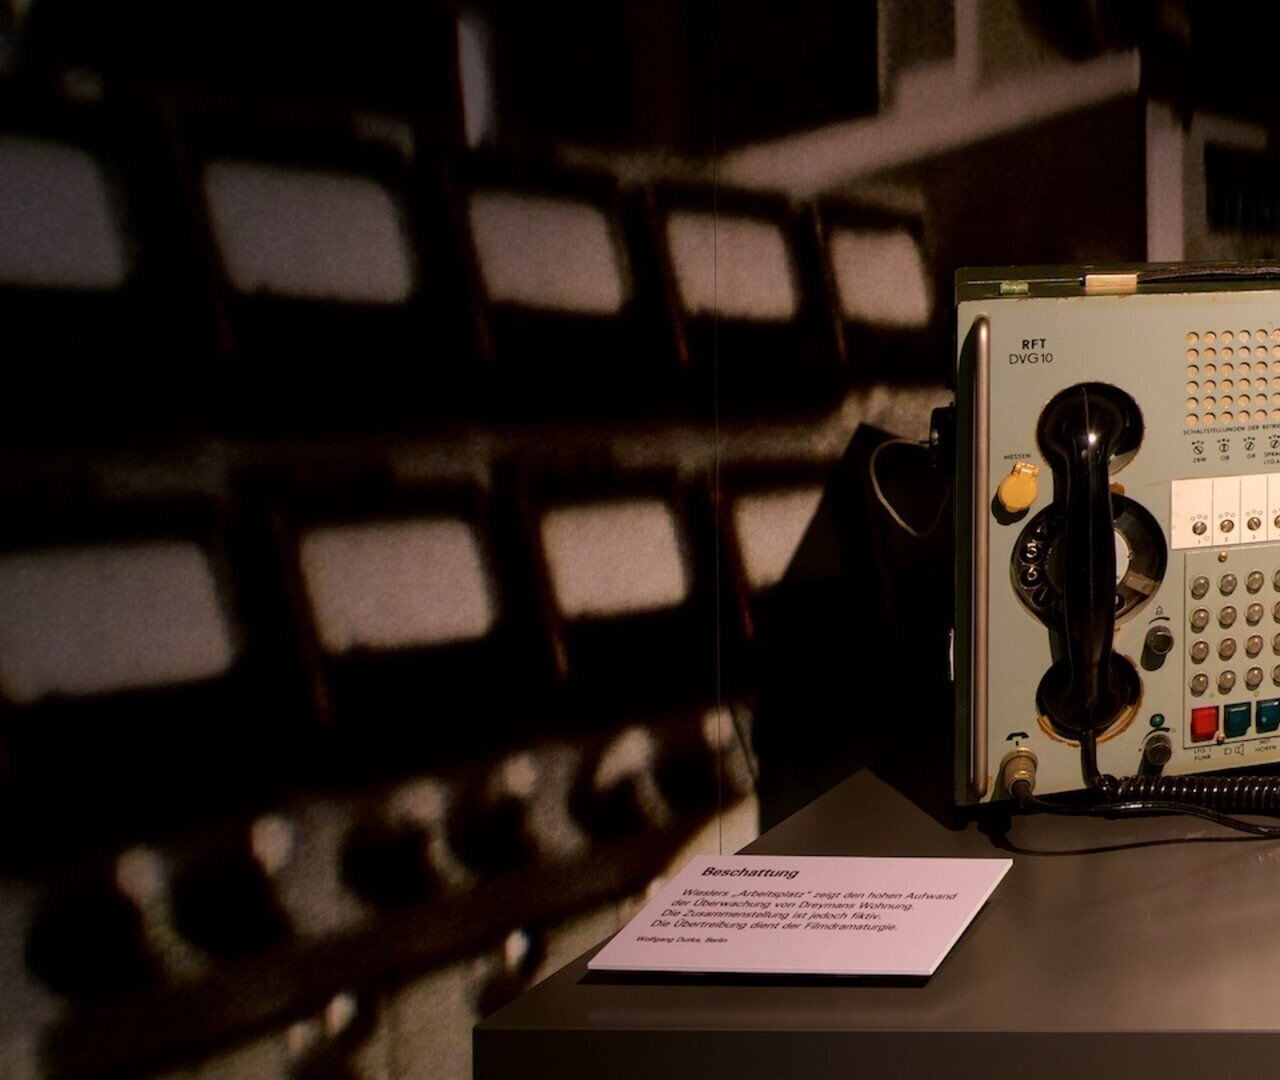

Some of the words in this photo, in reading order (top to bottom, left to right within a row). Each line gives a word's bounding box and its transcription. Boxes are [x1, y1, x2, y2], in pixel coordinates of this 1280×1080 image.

[1022, 338, 1047, 350] RFT
[1027, 567, 1037, 581] 6
[701, 866, 800, 880] Beschattung
[682, 888, 730, 897] Wieslers
[813, 892, 841, 900] zeigt
[867, 892, 903, 900] hohen
[905, 892, 958, 901] Aufwand
[692, 899, 772, 909] Überwachung
[798, 901, 856, 910] Dreymans
[859, 901, 915, 912] Wohnung.
[660, 909, 681, 917] Die
[682, 909, 790, 921] Zusammenstellung
[791, 911, 808, 919] ist
[808, 912, 848, 921] jedoch
[850, 912, 881, 920] fiktiv.
[650, 919, 671, 928] Die
[673, 919, 748, 930] Übertreibung
[750, 922, 780, 930] dient
[781, 922, 802, 930] der
[803, 922, 897, 933] Filmdramaturgie.
